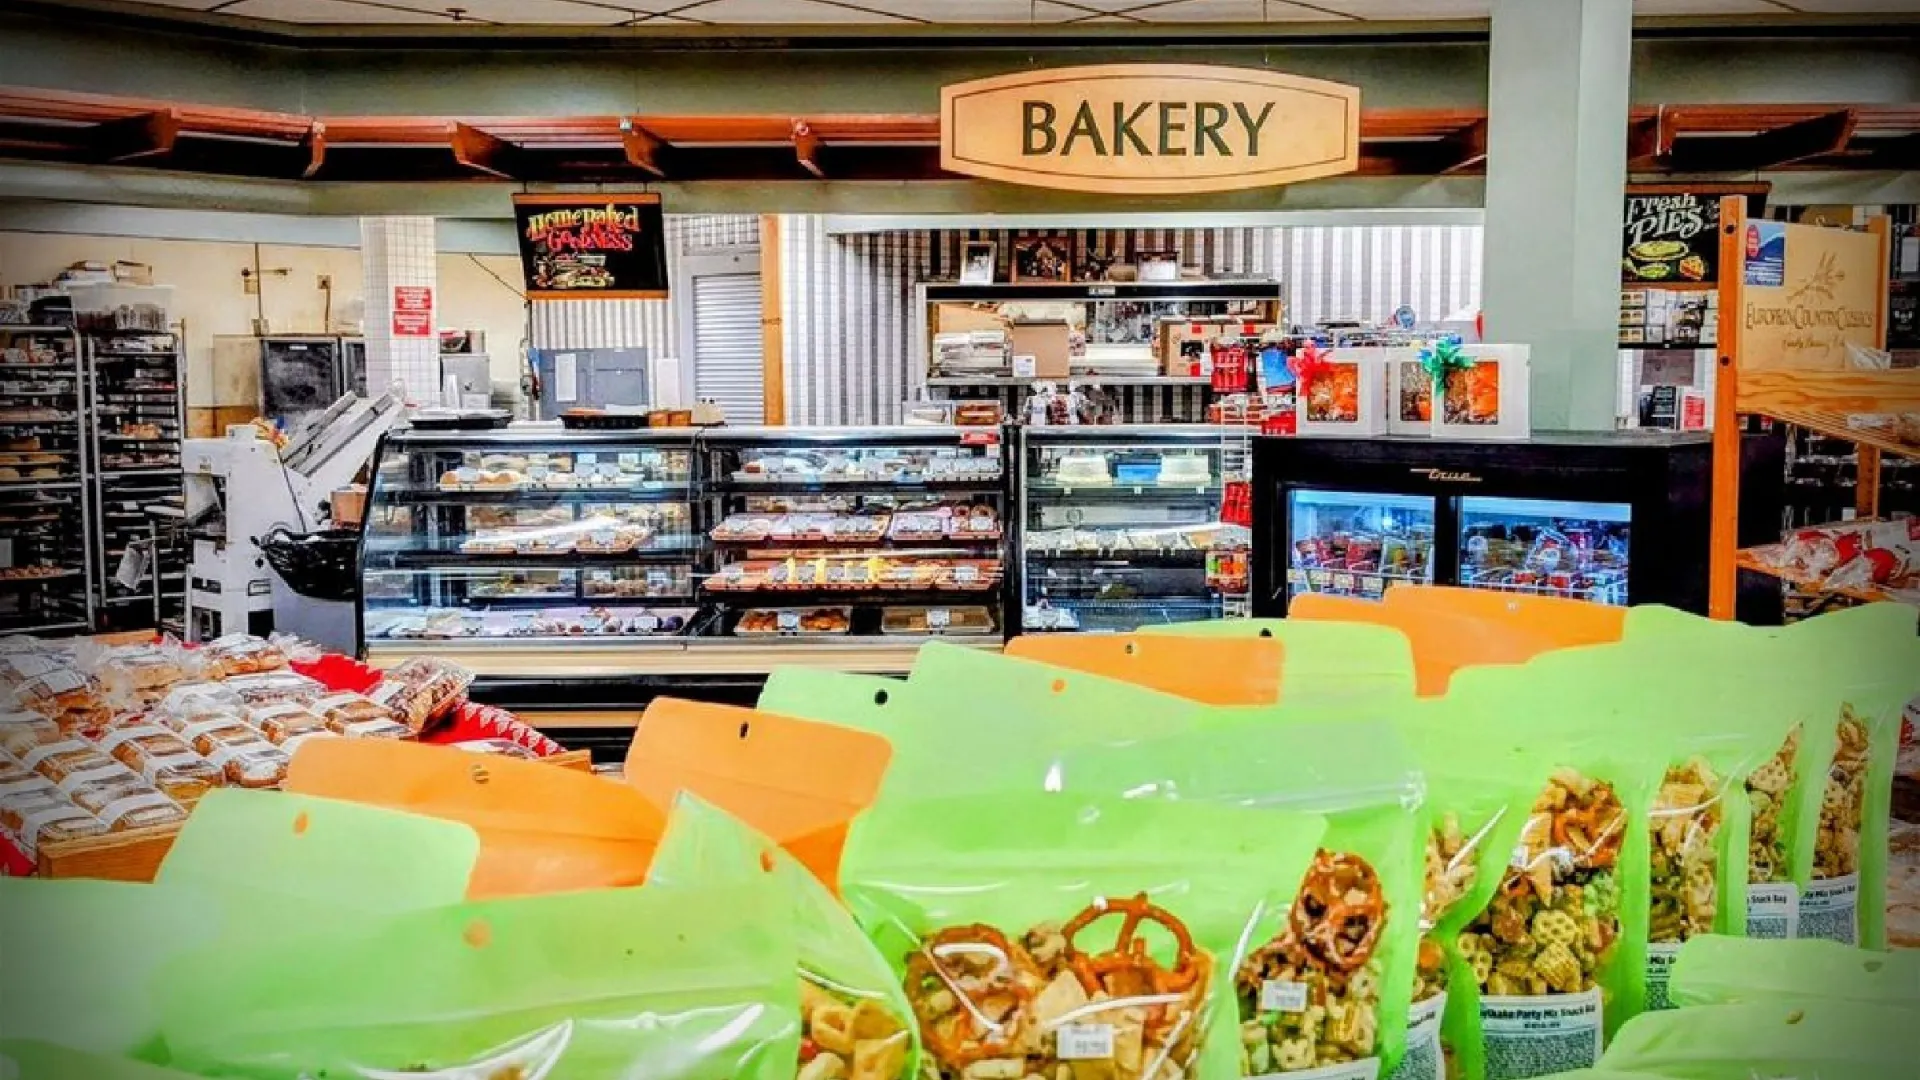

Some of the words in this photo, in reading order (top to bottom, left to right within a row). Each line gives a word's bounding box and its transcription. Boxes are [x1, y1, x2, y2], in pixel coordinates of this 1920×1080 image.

[1021, 99, 1276, 157] BAKERY
[1627, 193, 1697, 227] Fresh
[1629, 205, 1703, 246] PIES
